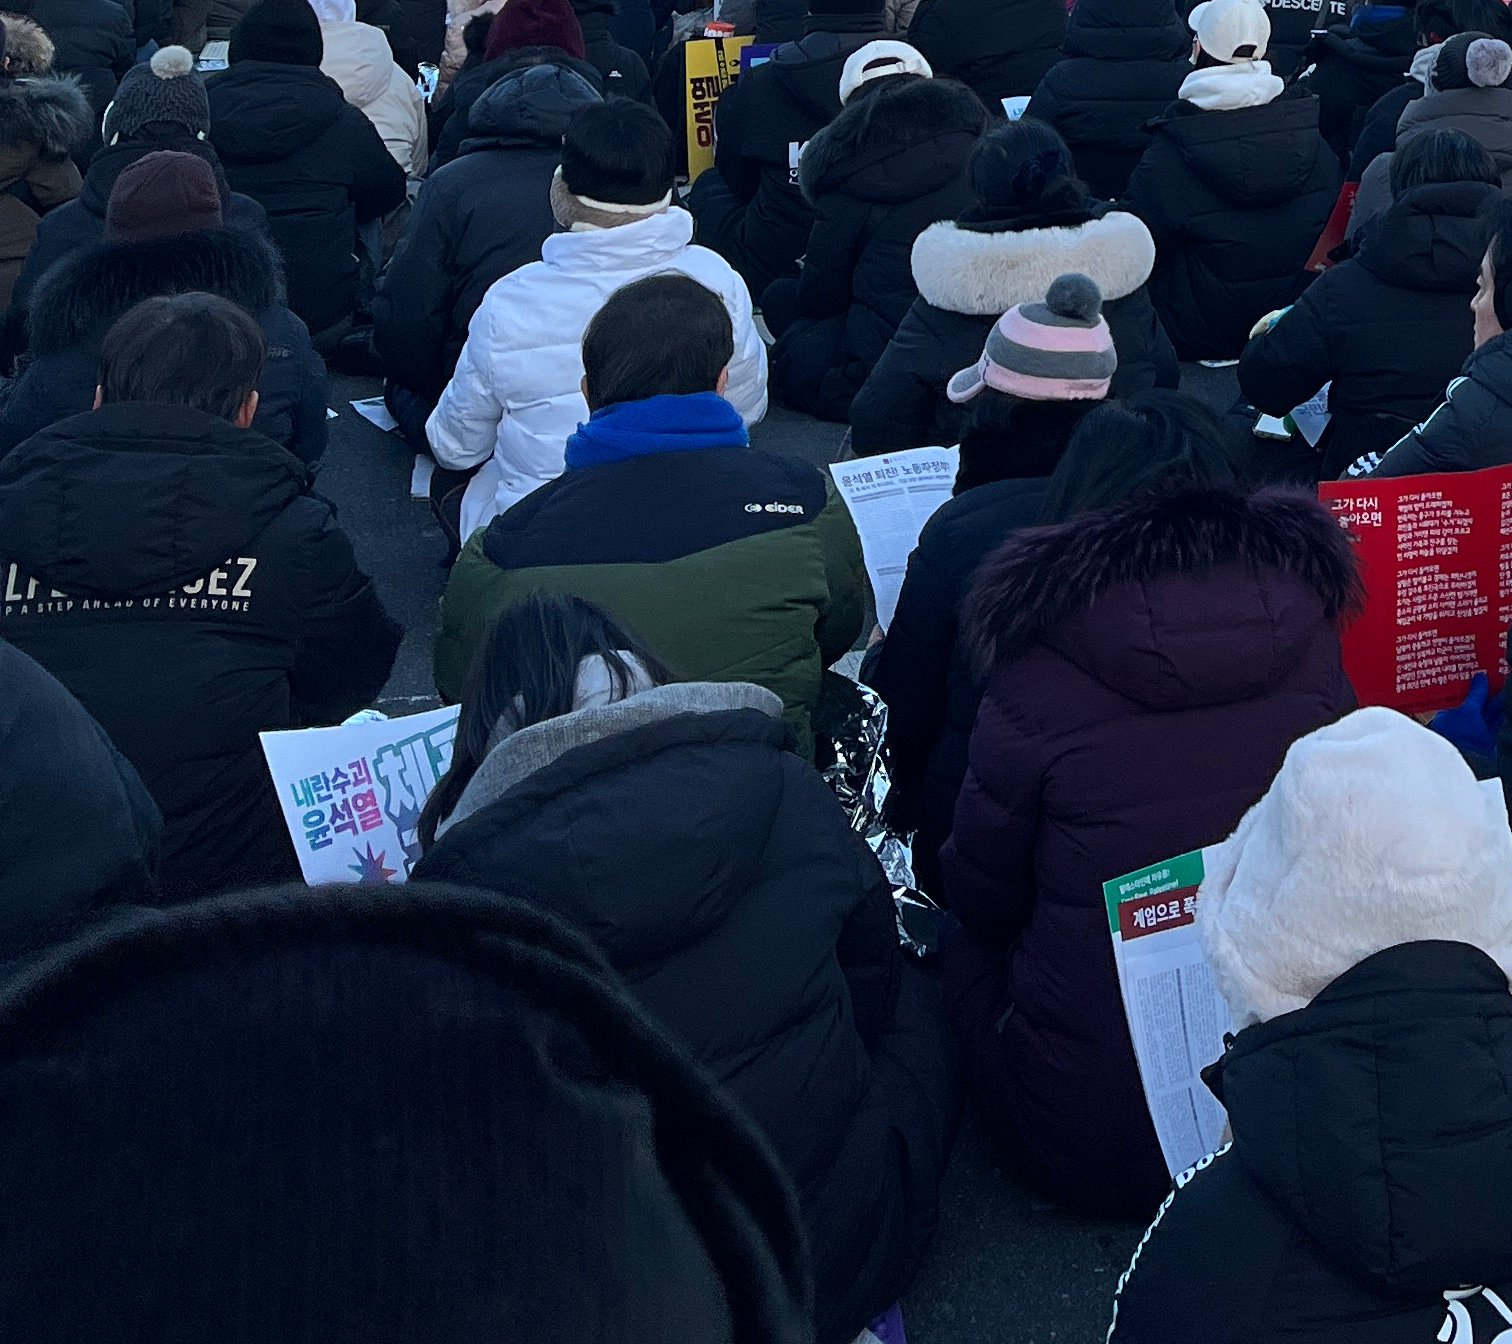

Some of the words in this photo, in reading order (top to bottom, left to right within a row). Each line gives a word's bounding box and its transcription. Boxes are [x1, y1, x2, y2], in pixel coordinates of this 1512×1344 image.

[1331, 499, 1354, 511] 그가
[1356, 497, 1379, 510] 다시
[143, 598, 161, 608] OF
[169, 597, 250, 612] EVERYONE
[290, 757, 373, 808] 내란수괴
[302, 788, 384, 852] 윤석열
[1133, 900, 1181, 928] 계엄으로
